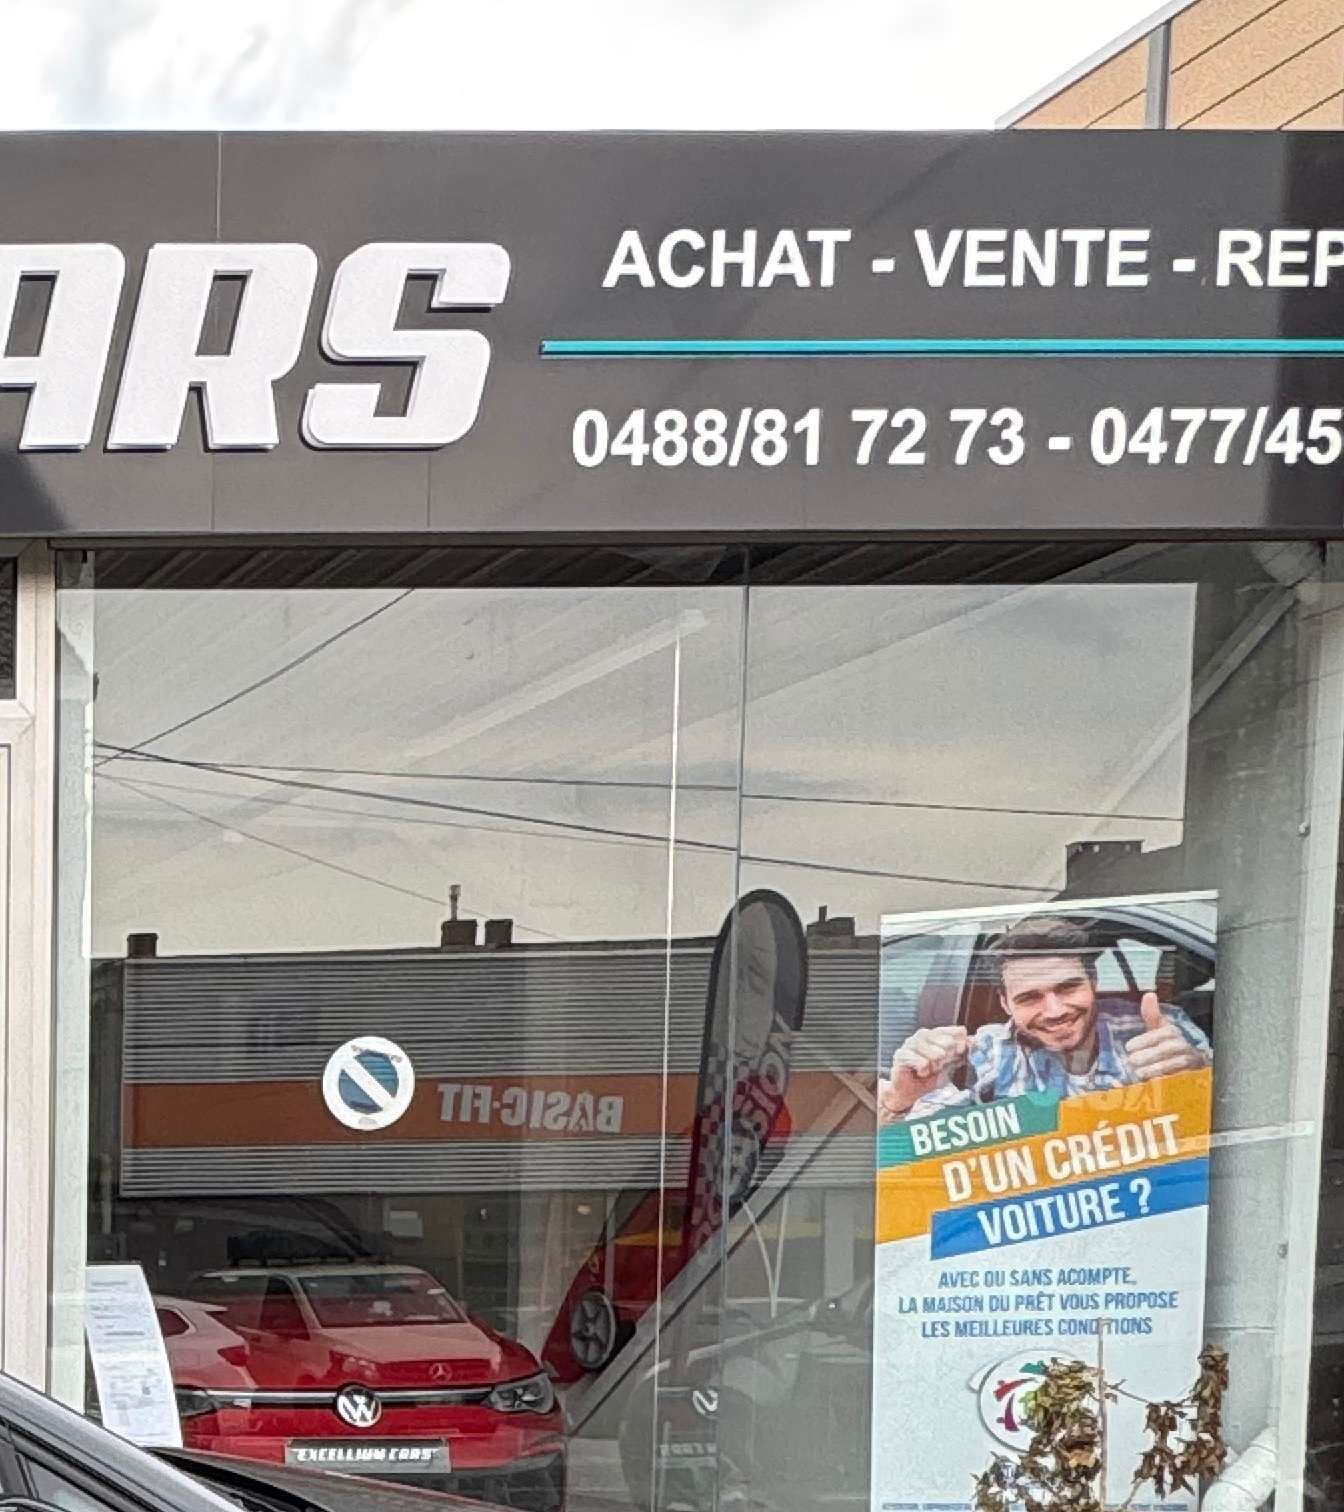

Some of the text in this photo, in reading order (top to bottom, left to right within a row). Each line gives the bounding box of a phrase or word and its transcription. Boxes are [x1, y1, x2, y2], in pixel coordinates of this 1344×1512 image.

[601, 228, 852, 288] ACHAT
[914, 228, 1152, 288] VENTE
[1216, 228, 1344, 288] REP
[571, 407, 821, 468] 0488/81
[852, 409, 927, 466] 72
[949, 408, 1026, 467] 73
[1090, 407, 1343, 468] 0477/45
[910, 1102, 1021, 1156] BESOIN
[942, 1114, 1180, 1202] D'UN CRÉDIT
[976, 1177, 1152, 1246] VOITURE ?
[898, 1289, 1180, 1314] LA MAISON DU PRÊT VOUS PROPOSE
[938, 1270, 979, 1289] AVEC
[984, 1269, 1005, 1287] OU
[1010, 1268, 1053, 1286] SANS
[921, 1316, 1153, 1338] LES MEILLEURES CONDTIONS
[297, 1447, 386, 1461] EXCELLIUM
